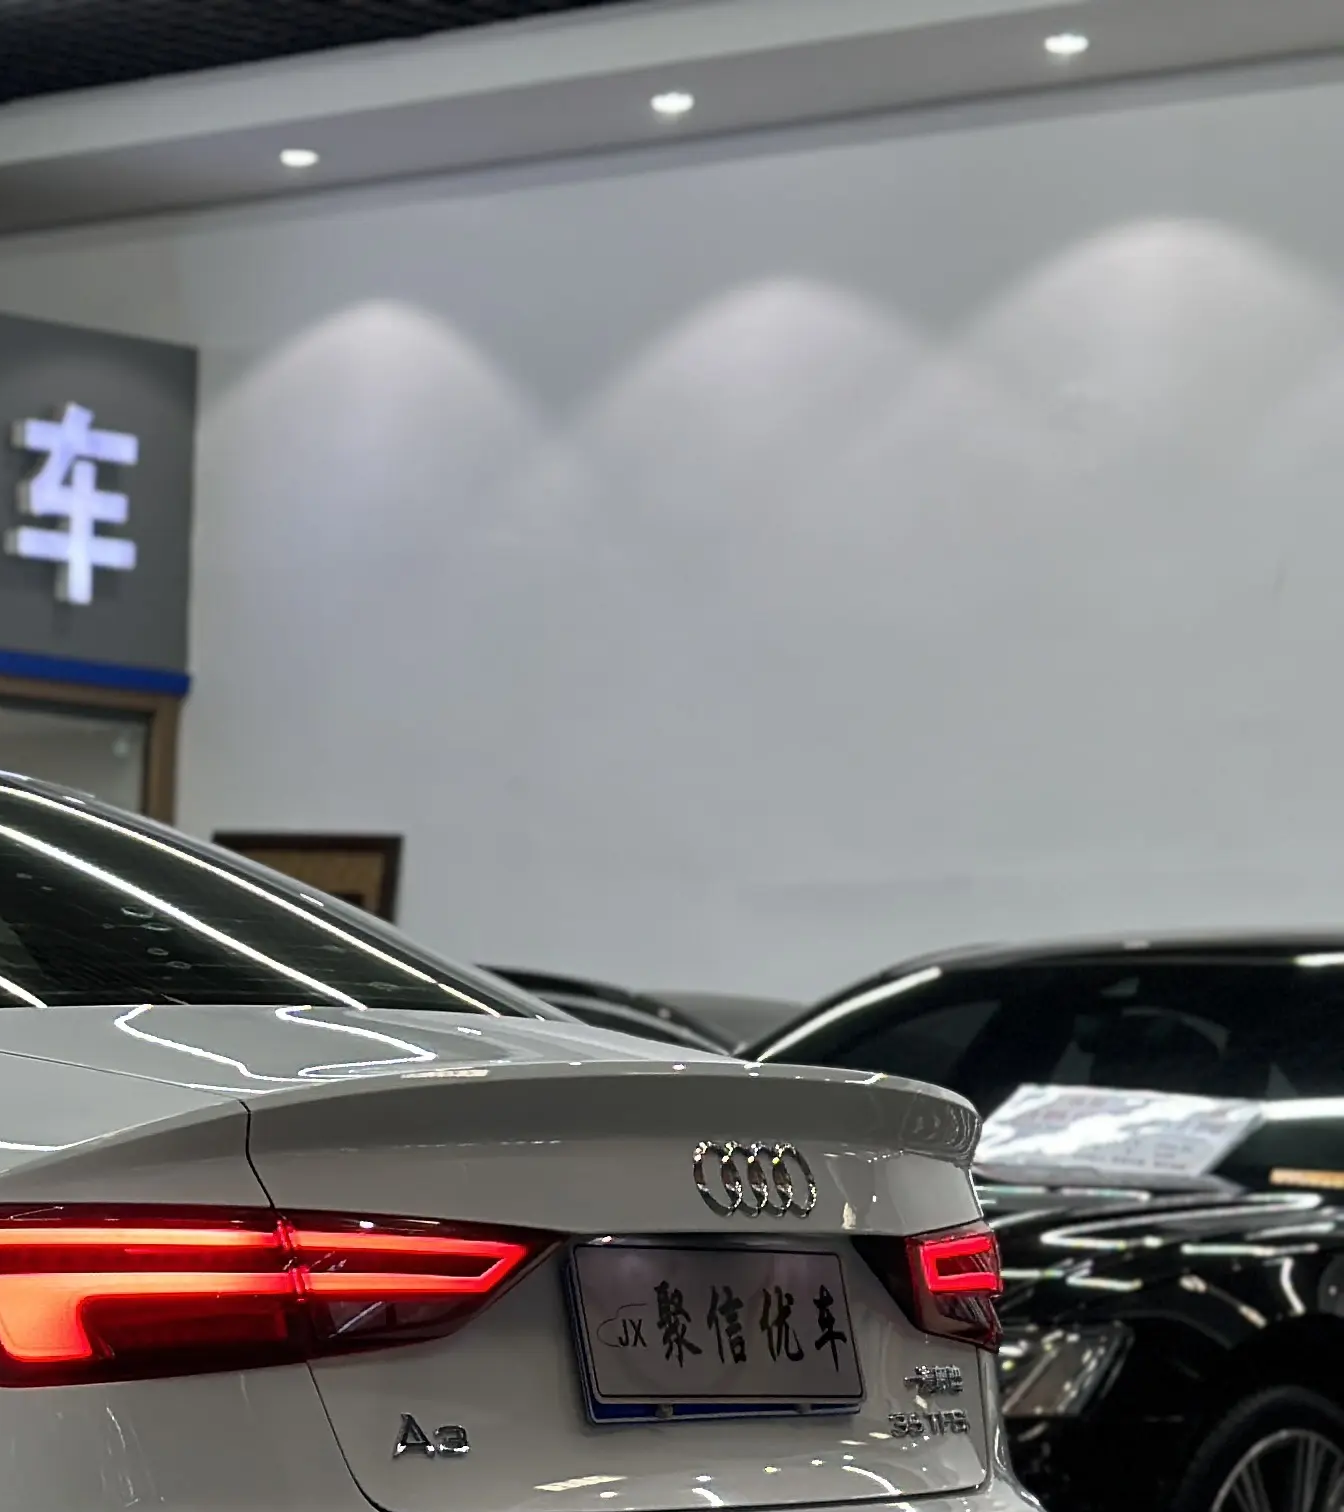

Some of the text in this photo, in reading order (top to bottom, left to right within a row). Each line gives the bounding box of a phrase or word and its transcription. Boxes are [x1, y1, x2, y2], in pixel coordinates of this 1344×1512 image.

[618, 1280, 848, 1373] JX 聚信优车
[392, 1412, 470, 1460] A3
